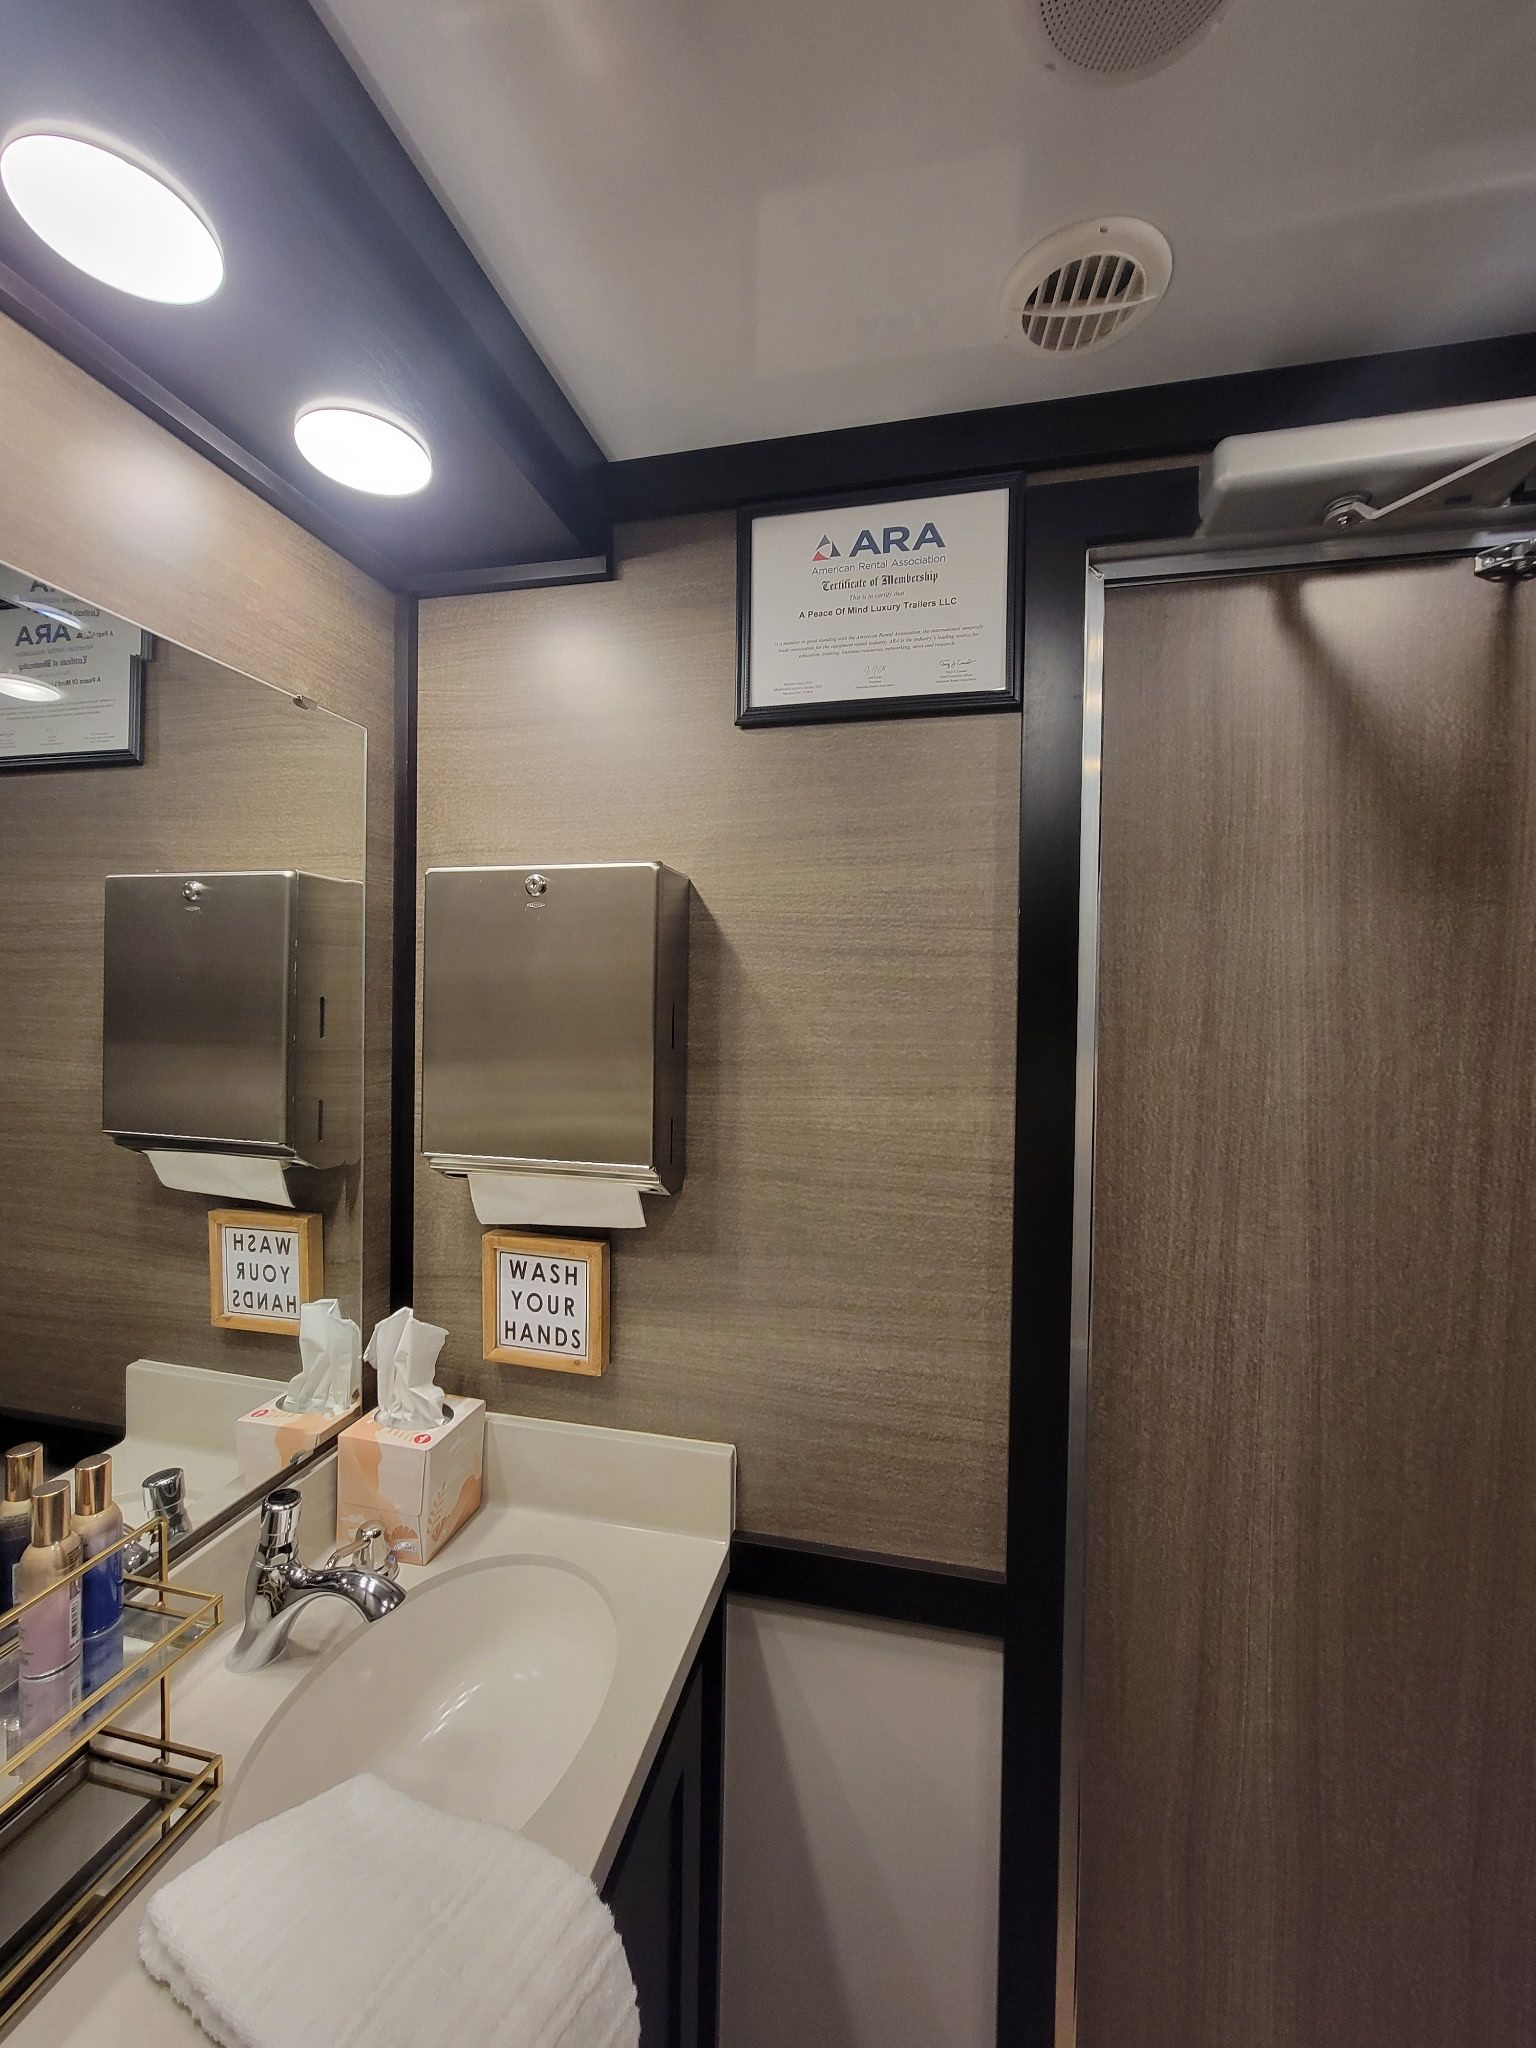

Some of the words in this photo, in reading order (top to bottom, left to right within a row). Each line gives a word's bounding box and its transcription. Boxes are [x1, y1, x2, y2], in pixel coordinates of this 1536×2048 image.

[848, 522, 946, 558] ARA
[812, 565, 856, 576] American
[858, 560, 888, 571] Rental
[891, 554, 946, 567] Association
[822, 579, 866, 592] Certificate
[869, 576, 878, 587] of
[881, 570, 938, 586] Membership
[798, 611, 806, 619] A
[808, 610, 832, 618] Peace
[836, 607, 846, 616] Of
[848, 606, 868, 615] Mind
[870, 604, 900, 613] Luxury
[904, 600, 936, 609] Trailers
[939, 597, 958, 606] LLC
[509, 1259, 578, 1287] WASH
[510, 1290, 575, 1317] YOUR
[505, 1320, 581, 1349] HANDS
